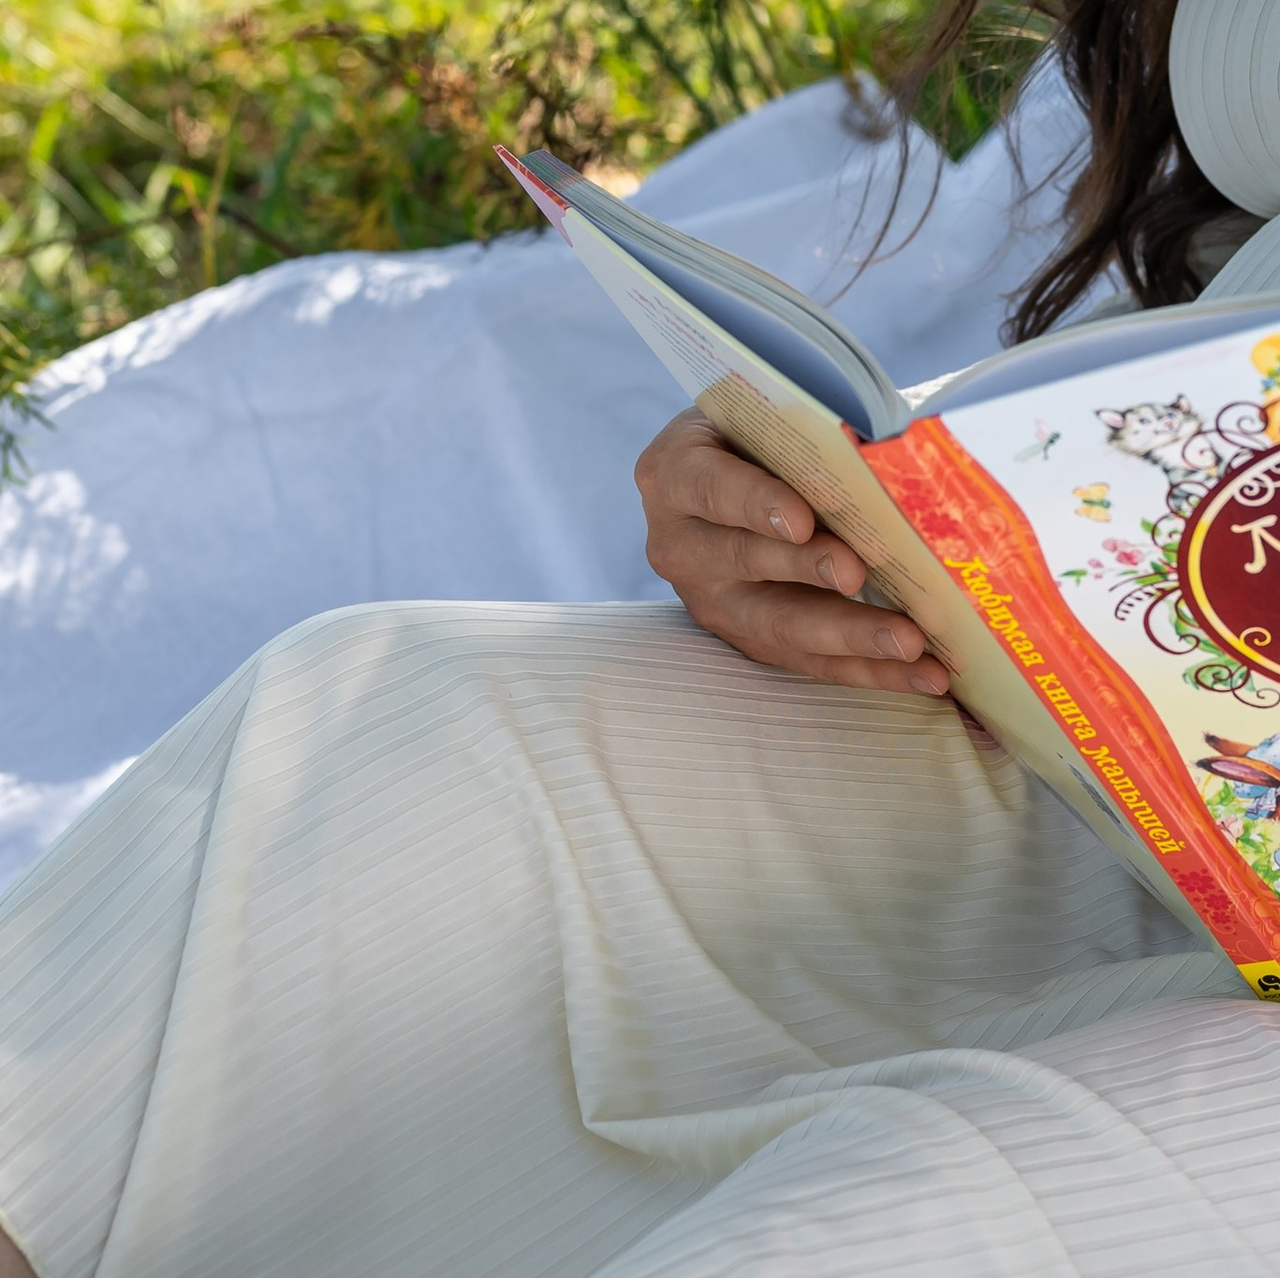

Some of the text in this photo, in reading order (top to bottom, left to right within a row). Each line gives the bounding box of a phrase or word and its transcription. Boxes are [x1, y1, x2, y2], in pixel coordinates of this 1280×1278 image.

[944, 555, 1187, 856] Любимая книга малышей
